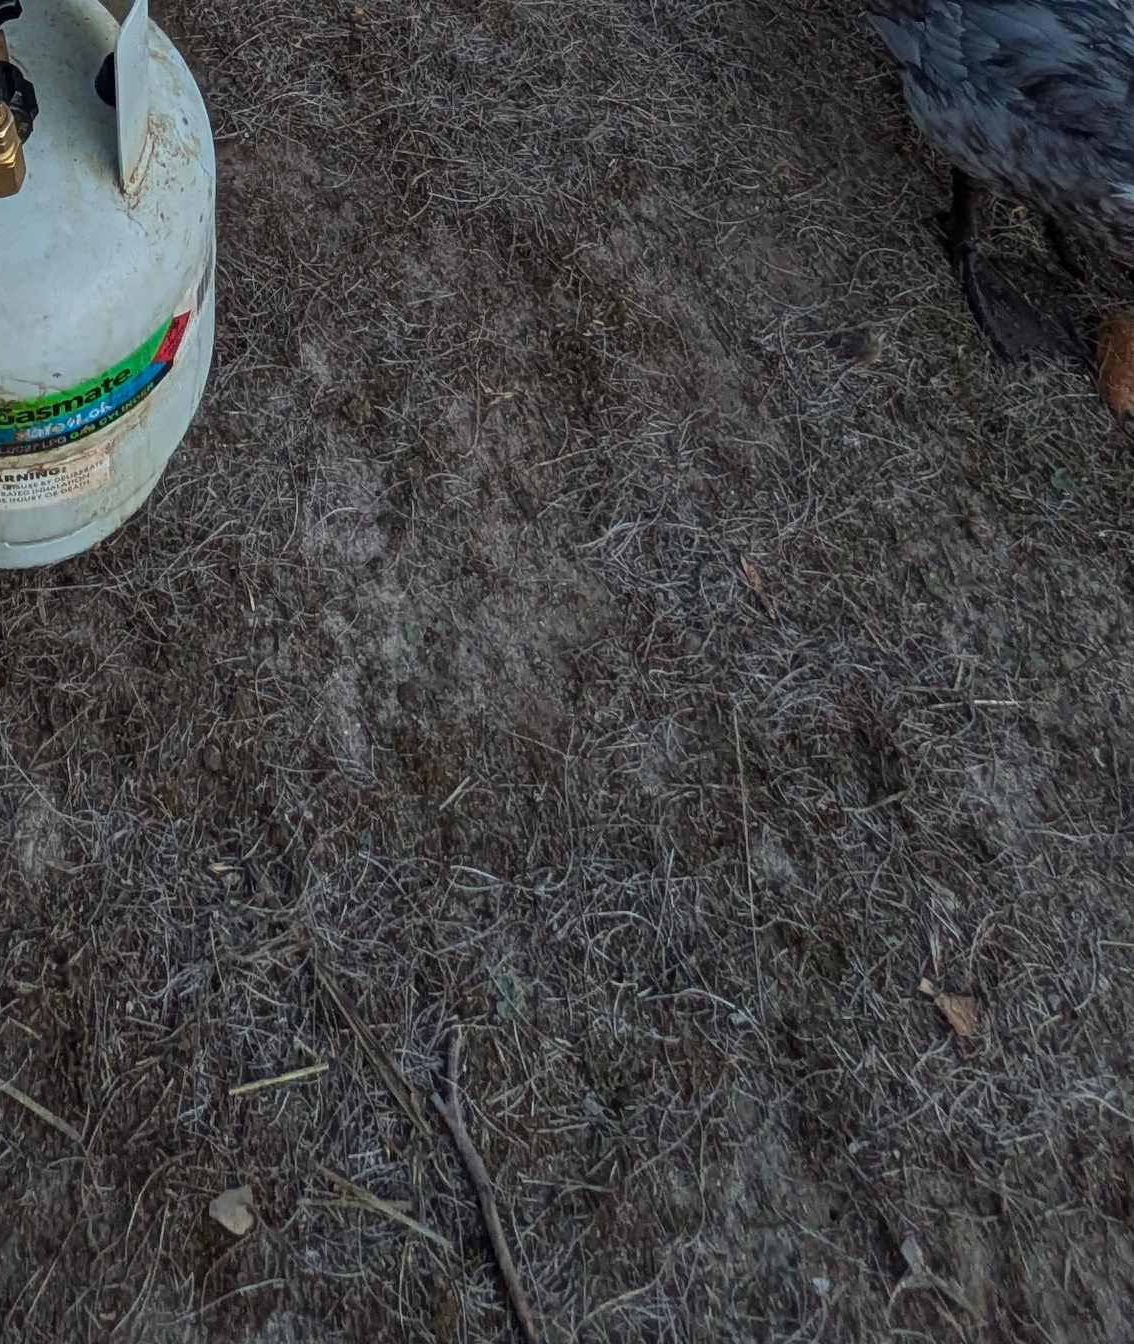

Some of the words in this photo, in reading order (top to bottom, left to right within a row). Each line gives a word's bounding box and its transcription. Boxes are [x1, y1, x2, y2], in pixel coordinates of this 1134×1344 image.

[69, 424, 96, 440] GAS
[98, 382, 154, 425] CYLINDER
[9, 493, 42, 504] INJURY
[44, 490, 59, 499] OR
[60, 479, 91, 496] DEATH
[32, 473, 91, 495] INHALATION
